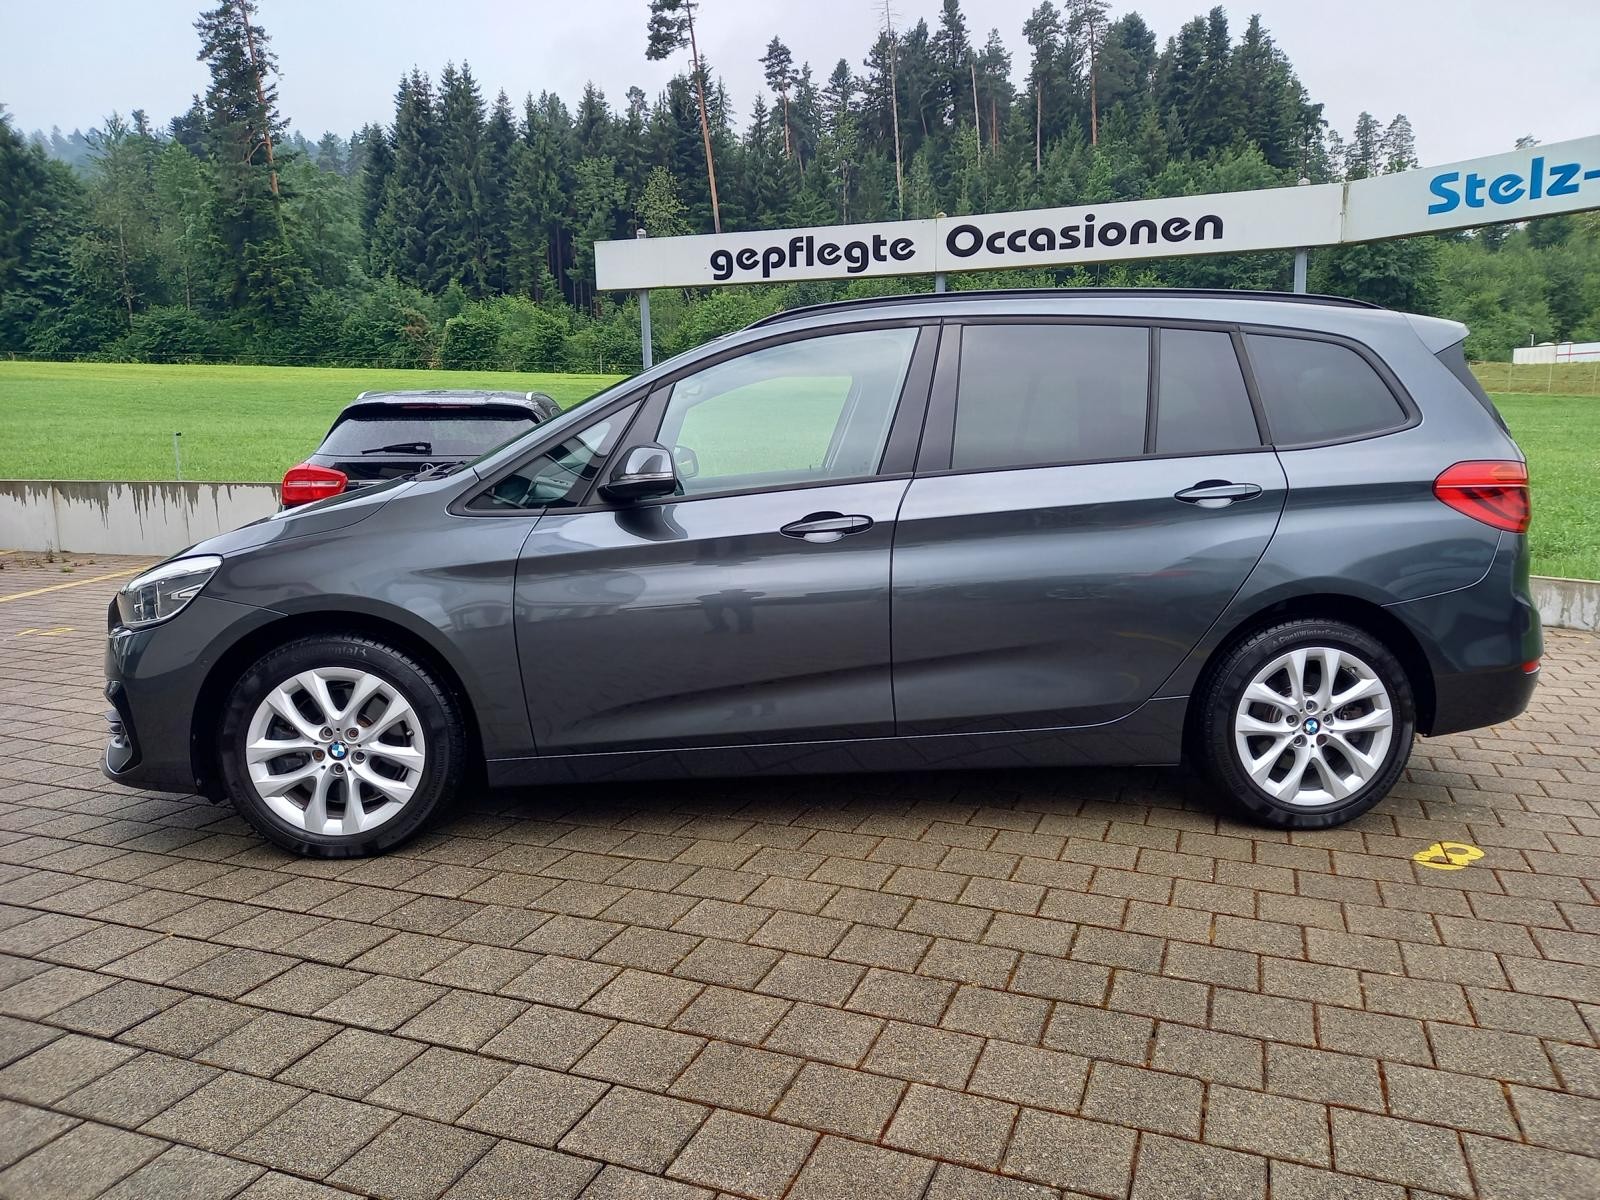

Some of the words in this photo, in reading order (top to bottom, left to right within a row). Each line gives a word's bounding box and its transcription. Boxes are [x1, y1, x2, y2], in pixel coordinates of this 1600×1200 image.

[1428, 156, 1600, 215] Stelz-
[709, 233, 917, 281] gepflegte
[945, 213, 1225, 259] Occasionen
